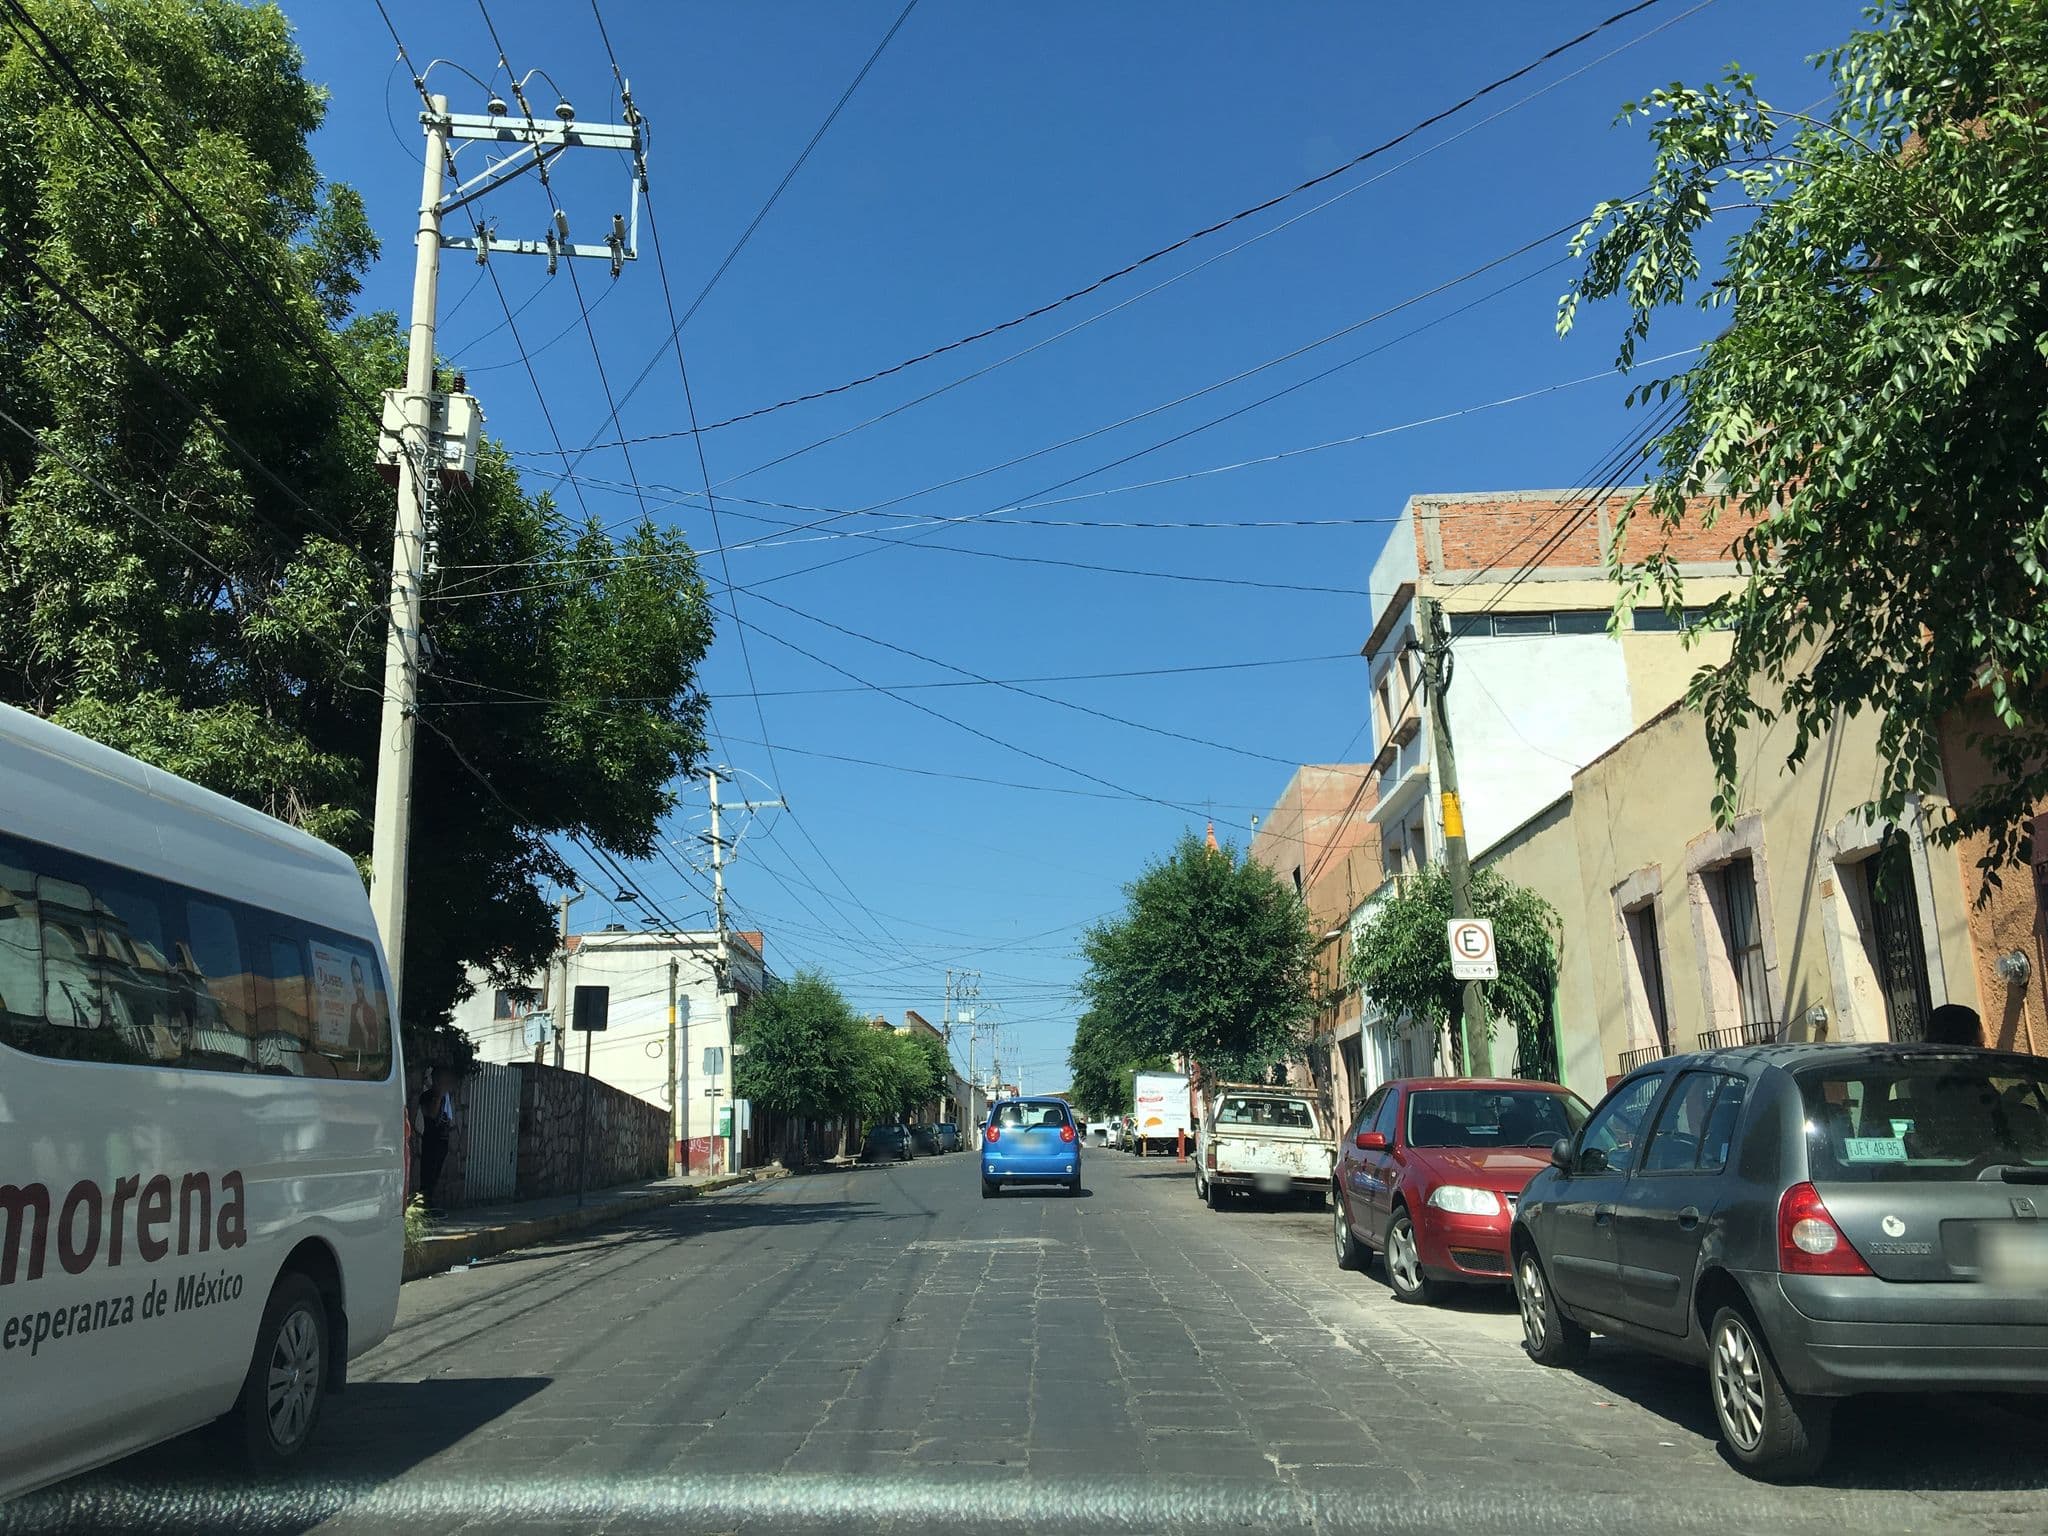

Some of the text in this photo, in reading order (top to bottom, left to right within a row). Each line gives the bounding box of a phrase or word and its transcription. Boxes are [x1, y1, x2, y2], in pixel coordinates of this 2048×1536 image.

[1463, 930, 1480, 951] E
[0, 1170, 247, 1286] morena
[3, 1269, 243, 1356] esperanza de México
